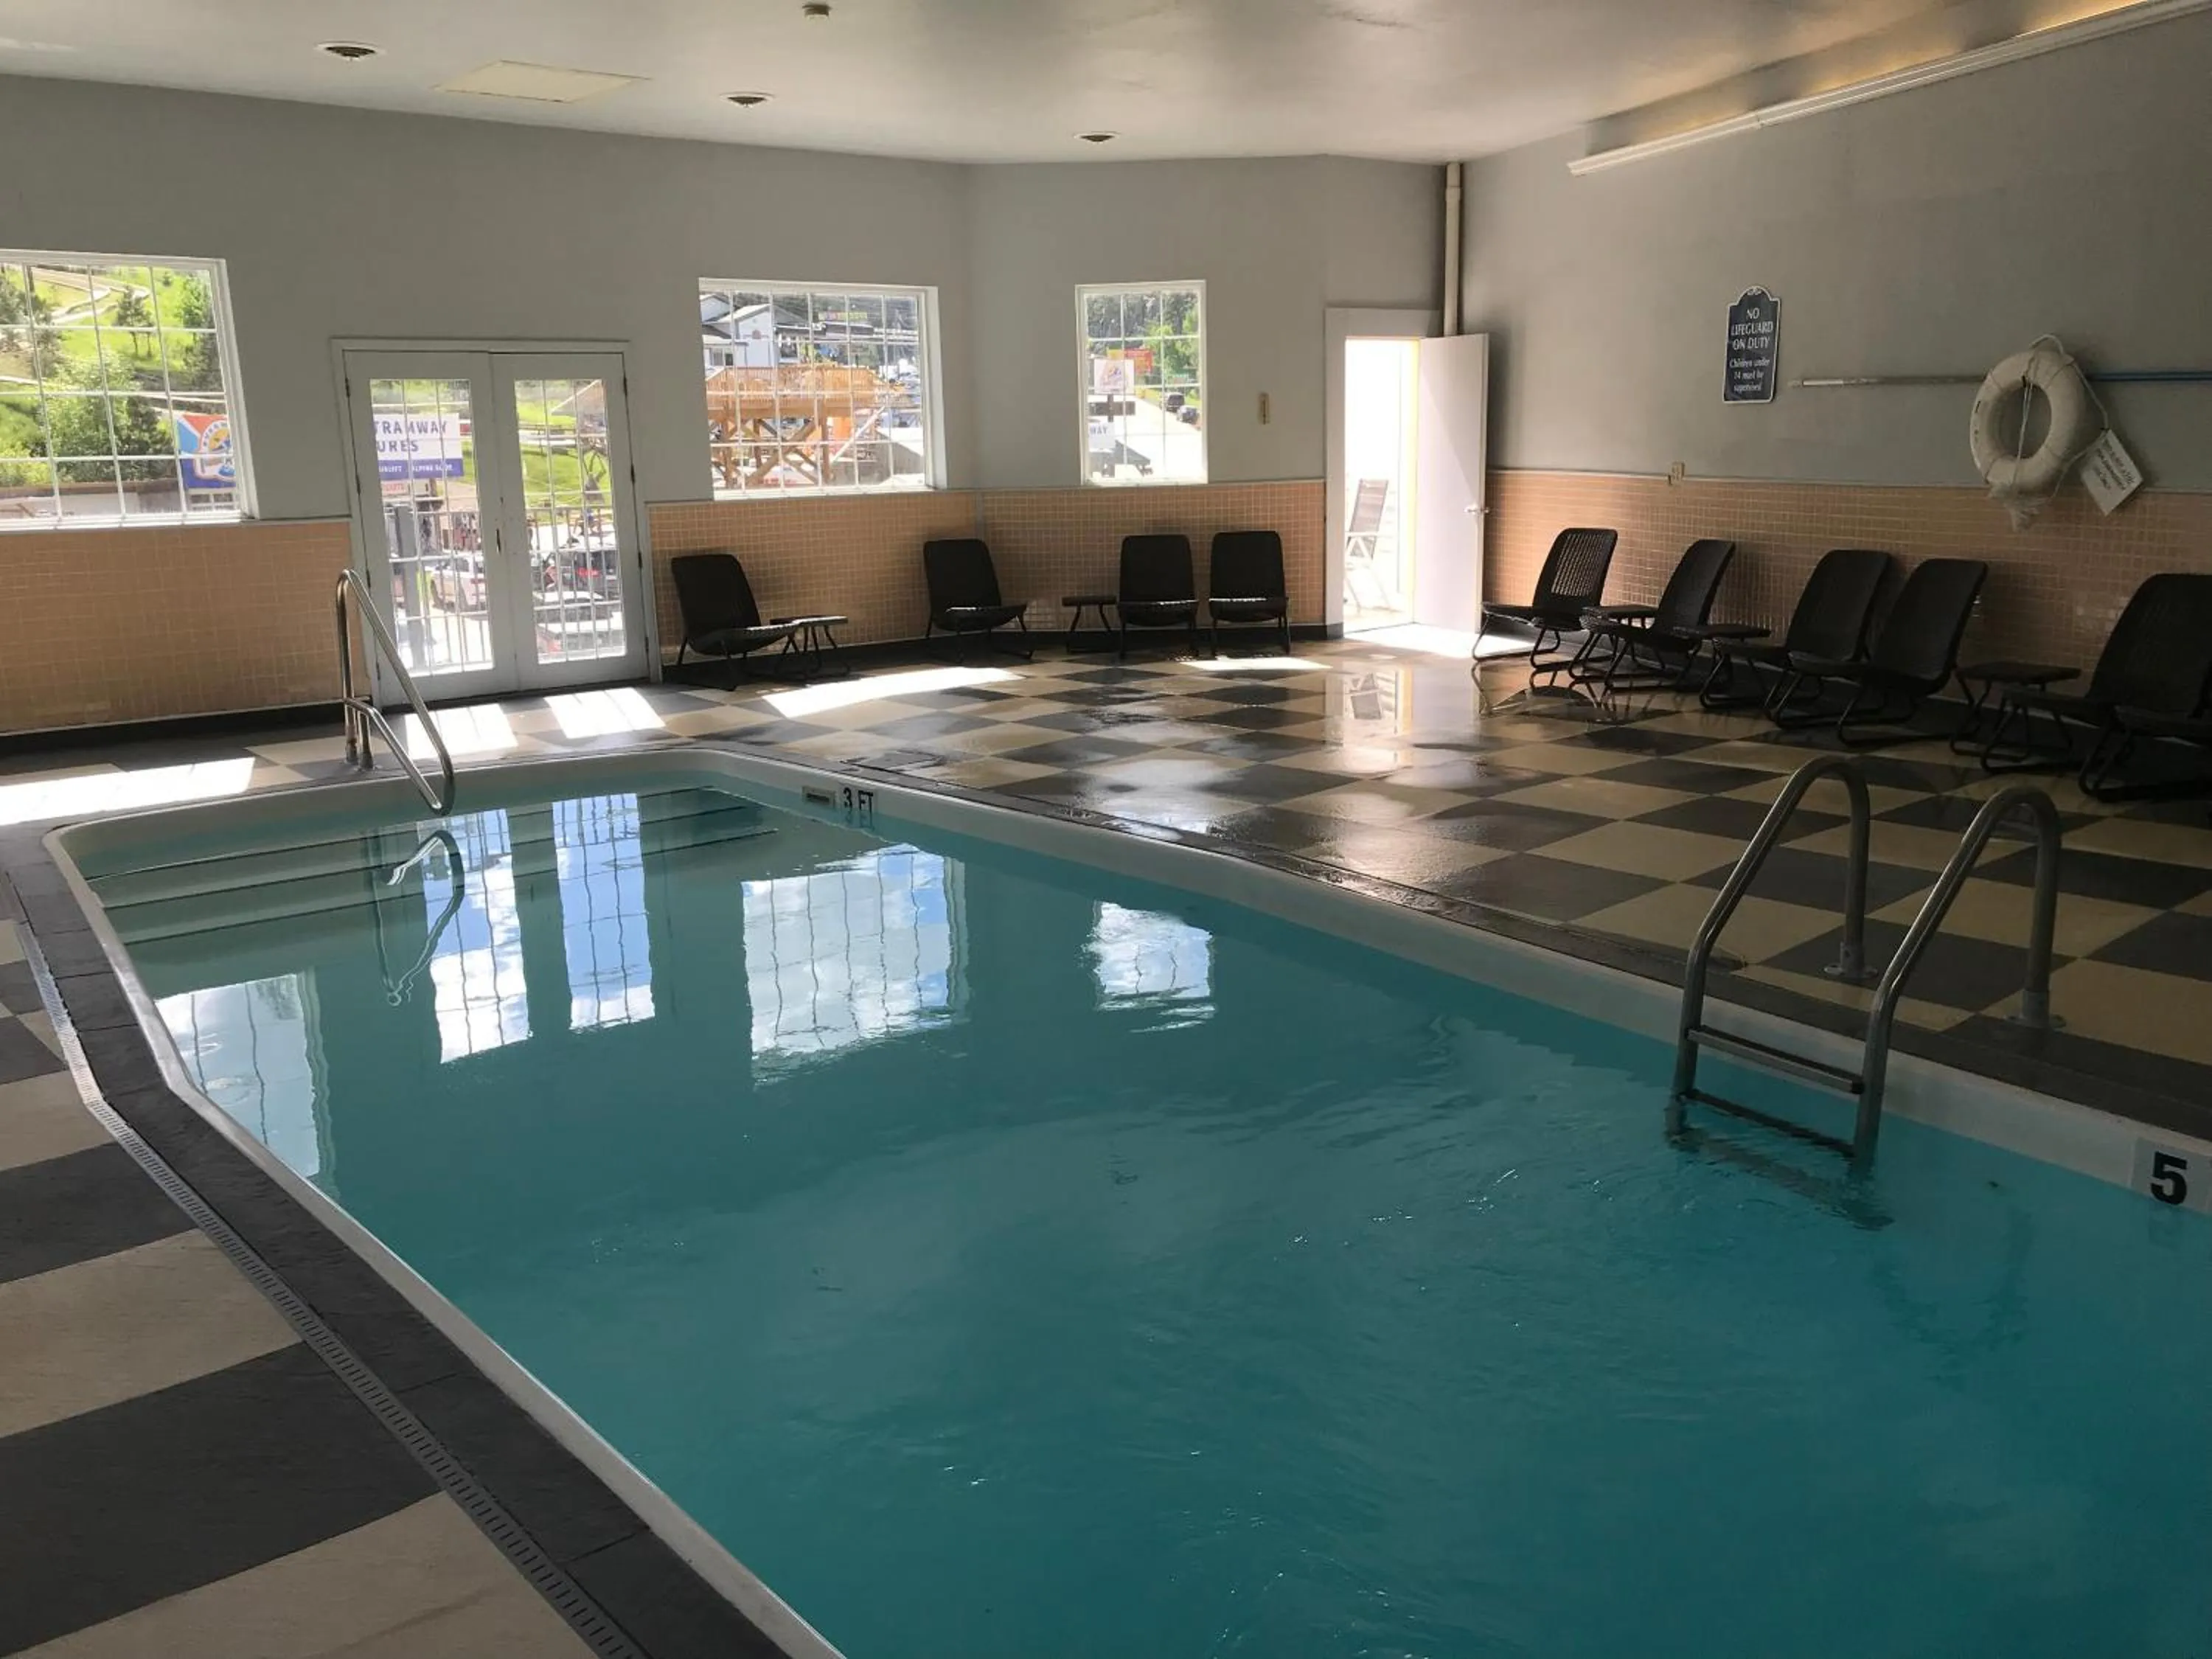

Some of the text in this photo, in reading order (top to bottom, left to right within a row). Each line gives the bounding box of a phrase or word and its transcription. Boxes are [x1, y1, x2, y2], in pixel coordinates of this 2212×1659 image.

[1746, 307, 1760, 319] NO
[1731, 321, 1773, 335] LIFEGUARD
[1733, 337, 1770, 350] ON DUTY
[1729, 358, 1753, 368] Children
[843, 787, 874, 812] 3 FT
[2150, 1151, 2188, 1205] 5
